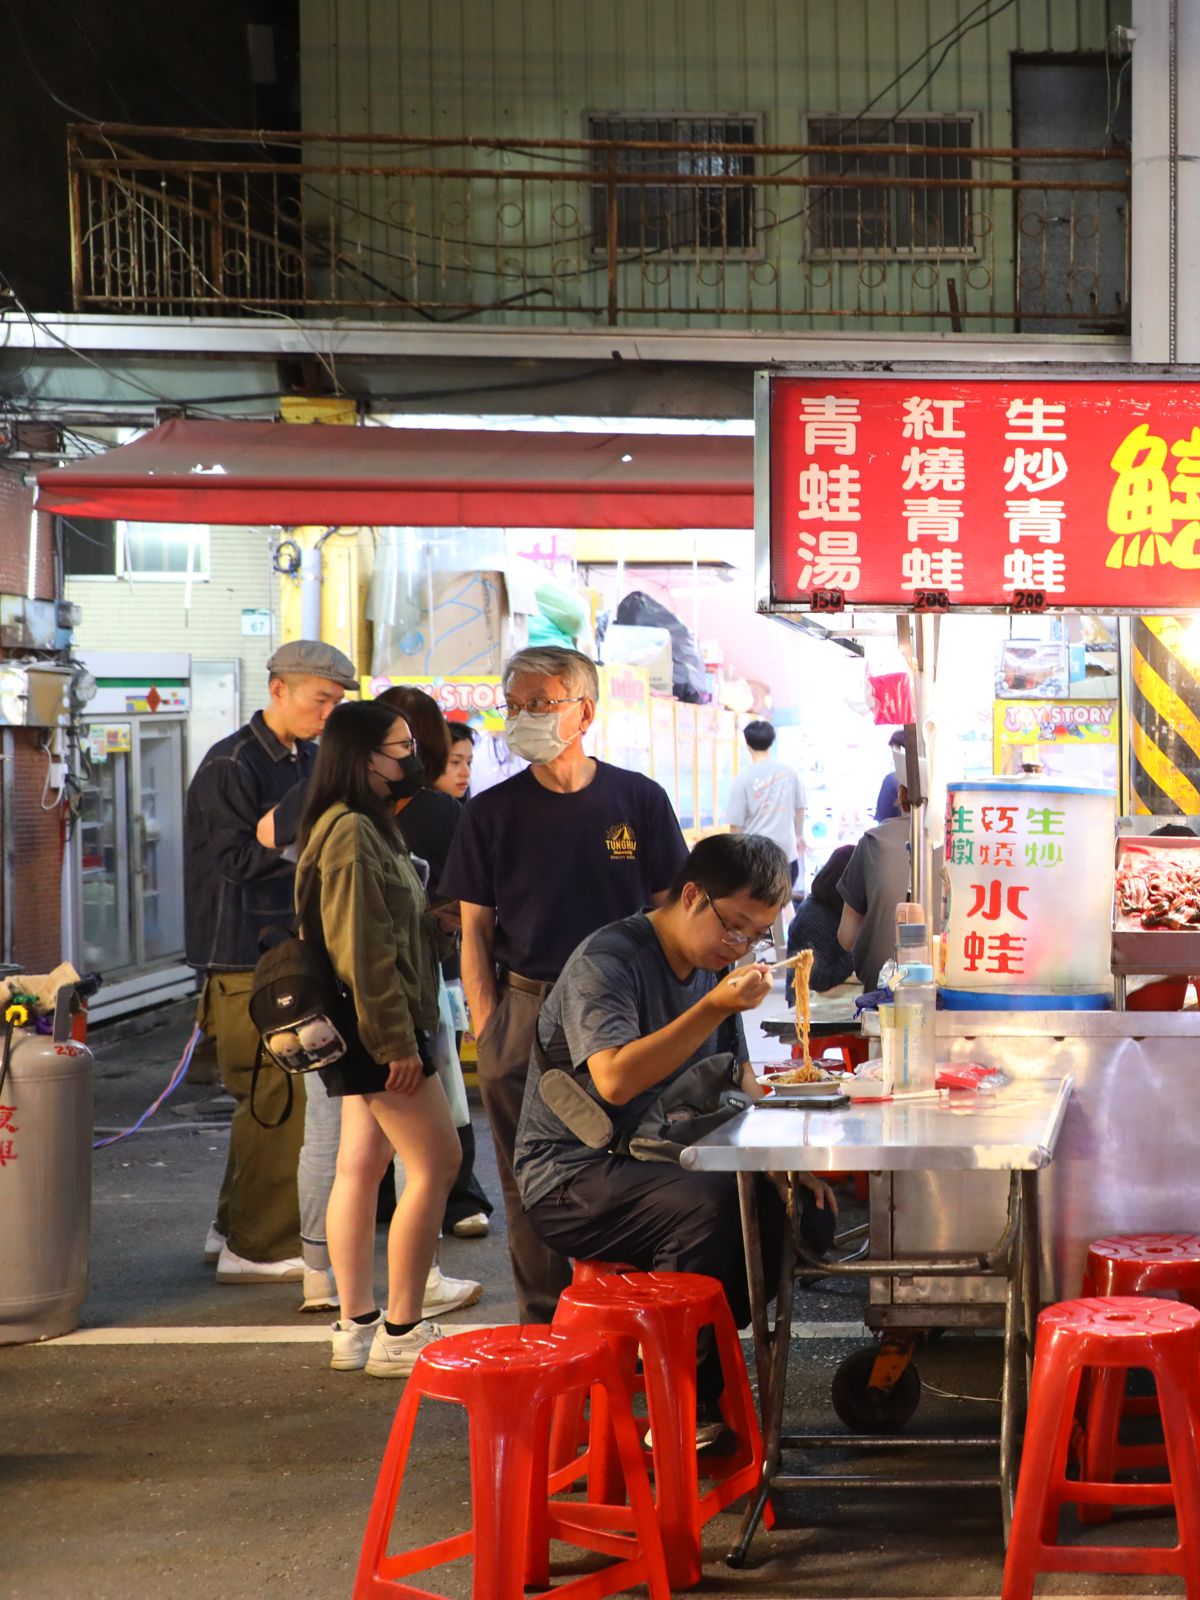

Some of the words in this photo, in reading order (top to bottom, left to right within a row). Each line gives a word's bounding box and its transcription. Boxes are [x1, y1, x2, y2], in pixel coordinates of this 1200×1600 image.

[797, 395, 861, 592] 青蛙湯
[901, 396, 966, 592] 紅燒青蛙
[1003, 398, 1068, 593] 生炒青蛙
[916, 591, 948, 609] 200
[1015, 591, 1044, 608] 200
[1006, 706, 1045, 724] TOY
[1050, 705, 1114, 724] STORY
[606, 839, 637, 851] TUNGHAI
[963, 879, 1031, 975] 水蛙
